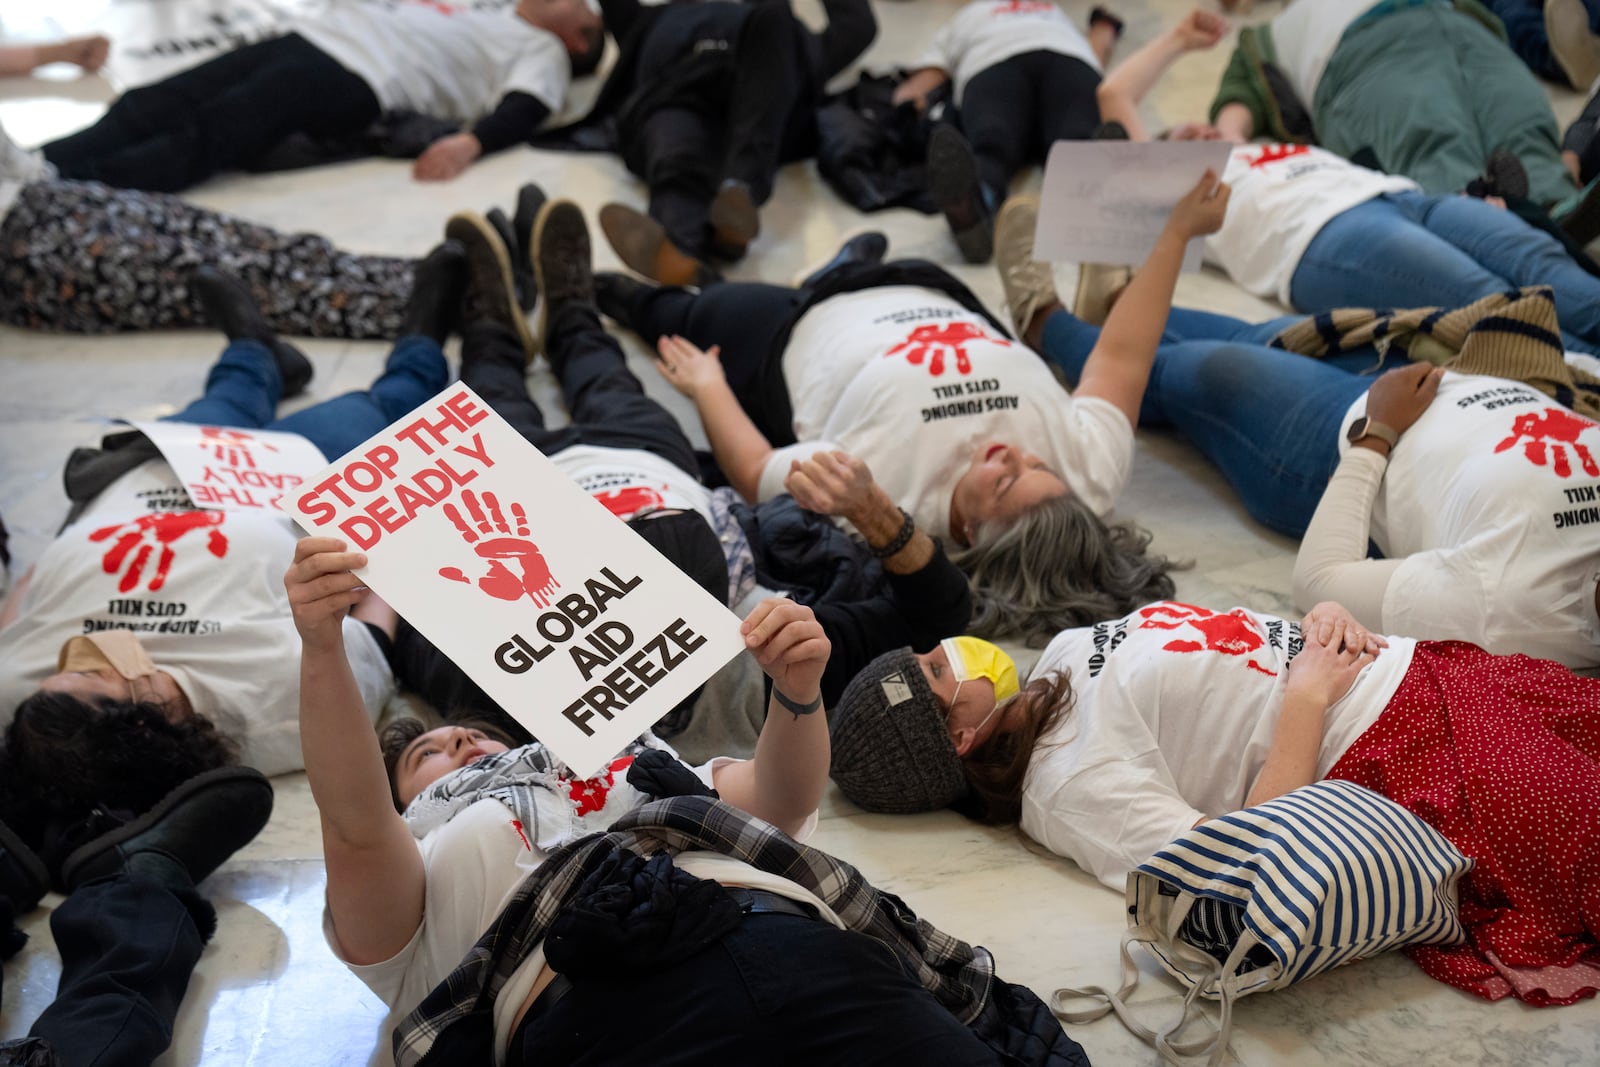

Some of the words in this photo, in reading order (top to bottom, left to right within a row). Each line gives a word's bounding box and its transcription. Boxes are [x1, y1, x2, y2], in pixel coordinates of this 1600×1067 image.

[932, 382, 963, 400] KILL
[966, 378, 1000, 395] CUTS
[921, 399, 984, 423] FUNDING
[986, 395, 1019, 411] AIDS
[297, 445, 399, 527] STOP
[394, 391, 489, 456] THE
[203, 466, 303, 489] EADLY
[189, 484, 264, 508] THE
[338, 432, 496, 551] DEADLY
[1563, 485, 1597, 505] KILL
[1553, 507, 1600, 530] NDING
[146, 600, 186, 617] CUTS
[494, 566, 643, 674] GLOBAL
[568, 620, 634, 682] AID
[561, 617, 708, 737] FREEZE
